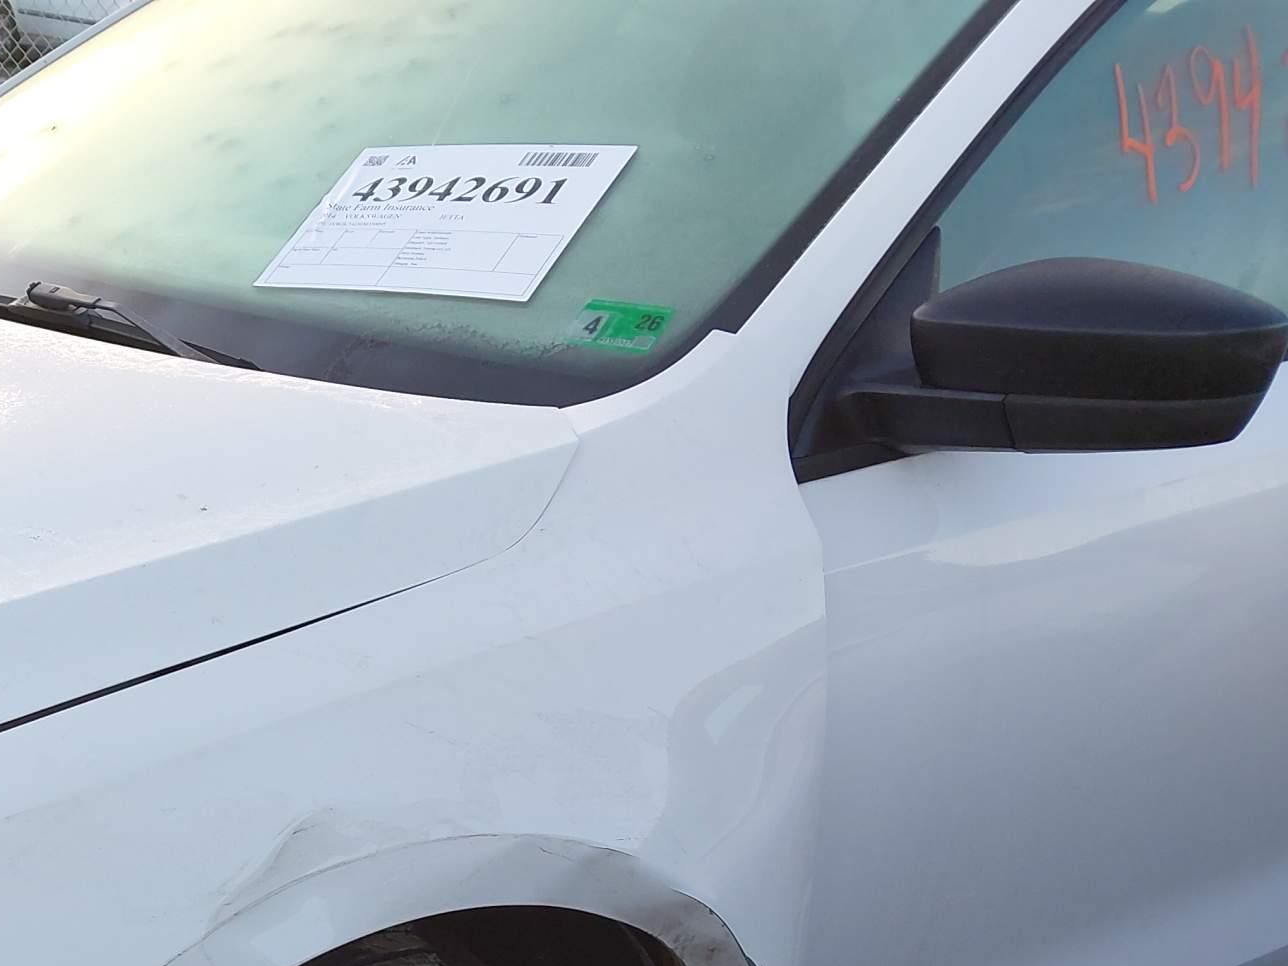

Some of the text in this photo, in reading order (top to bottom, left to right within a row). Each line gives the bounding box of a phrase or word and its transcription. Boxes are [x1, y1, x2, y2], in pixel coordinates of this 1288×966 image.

[1114, 24, 1288, 207] 4394
[352, 176, 569, 205] 43942691
[327, 202, 436, 213] State Farm Insurance
[583, 315, 603, 335] 4
[634, 313, 665, 332] 26
